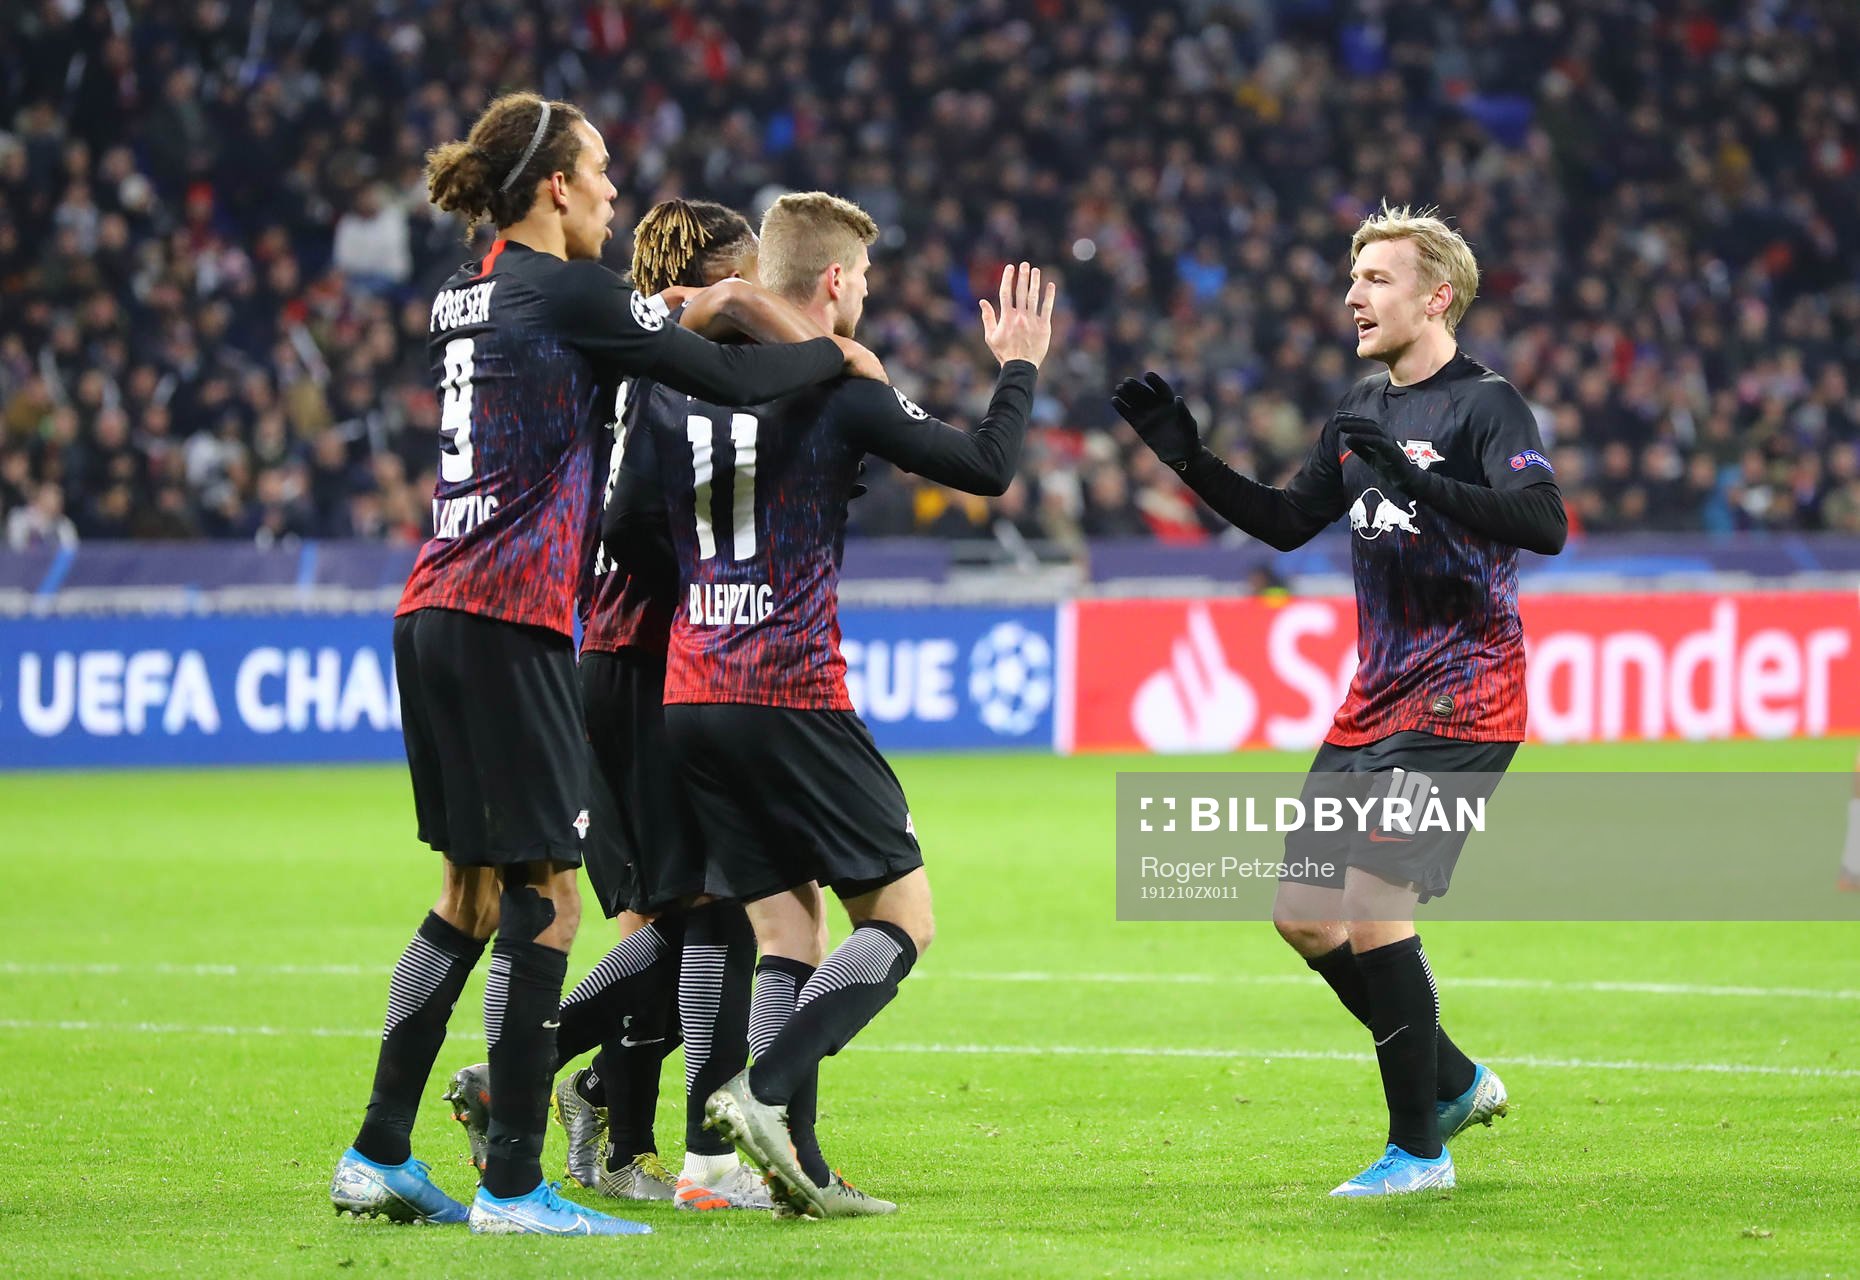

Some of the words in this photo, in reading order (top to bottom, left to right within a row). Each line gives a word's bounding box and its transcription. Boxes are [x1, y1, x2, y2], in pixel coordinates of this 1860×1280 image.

[430, 281, 497, 332] POULSEN
[439, 338, 475, 482] 9
[686, 413, 758, 561] 11
[705, 583, 774, 625] LEIPZIG
[18, 648, 220, 737] UEFA
[236, 645, 402, 733] CHA
[1264, 598, 1850, 750] Sander
